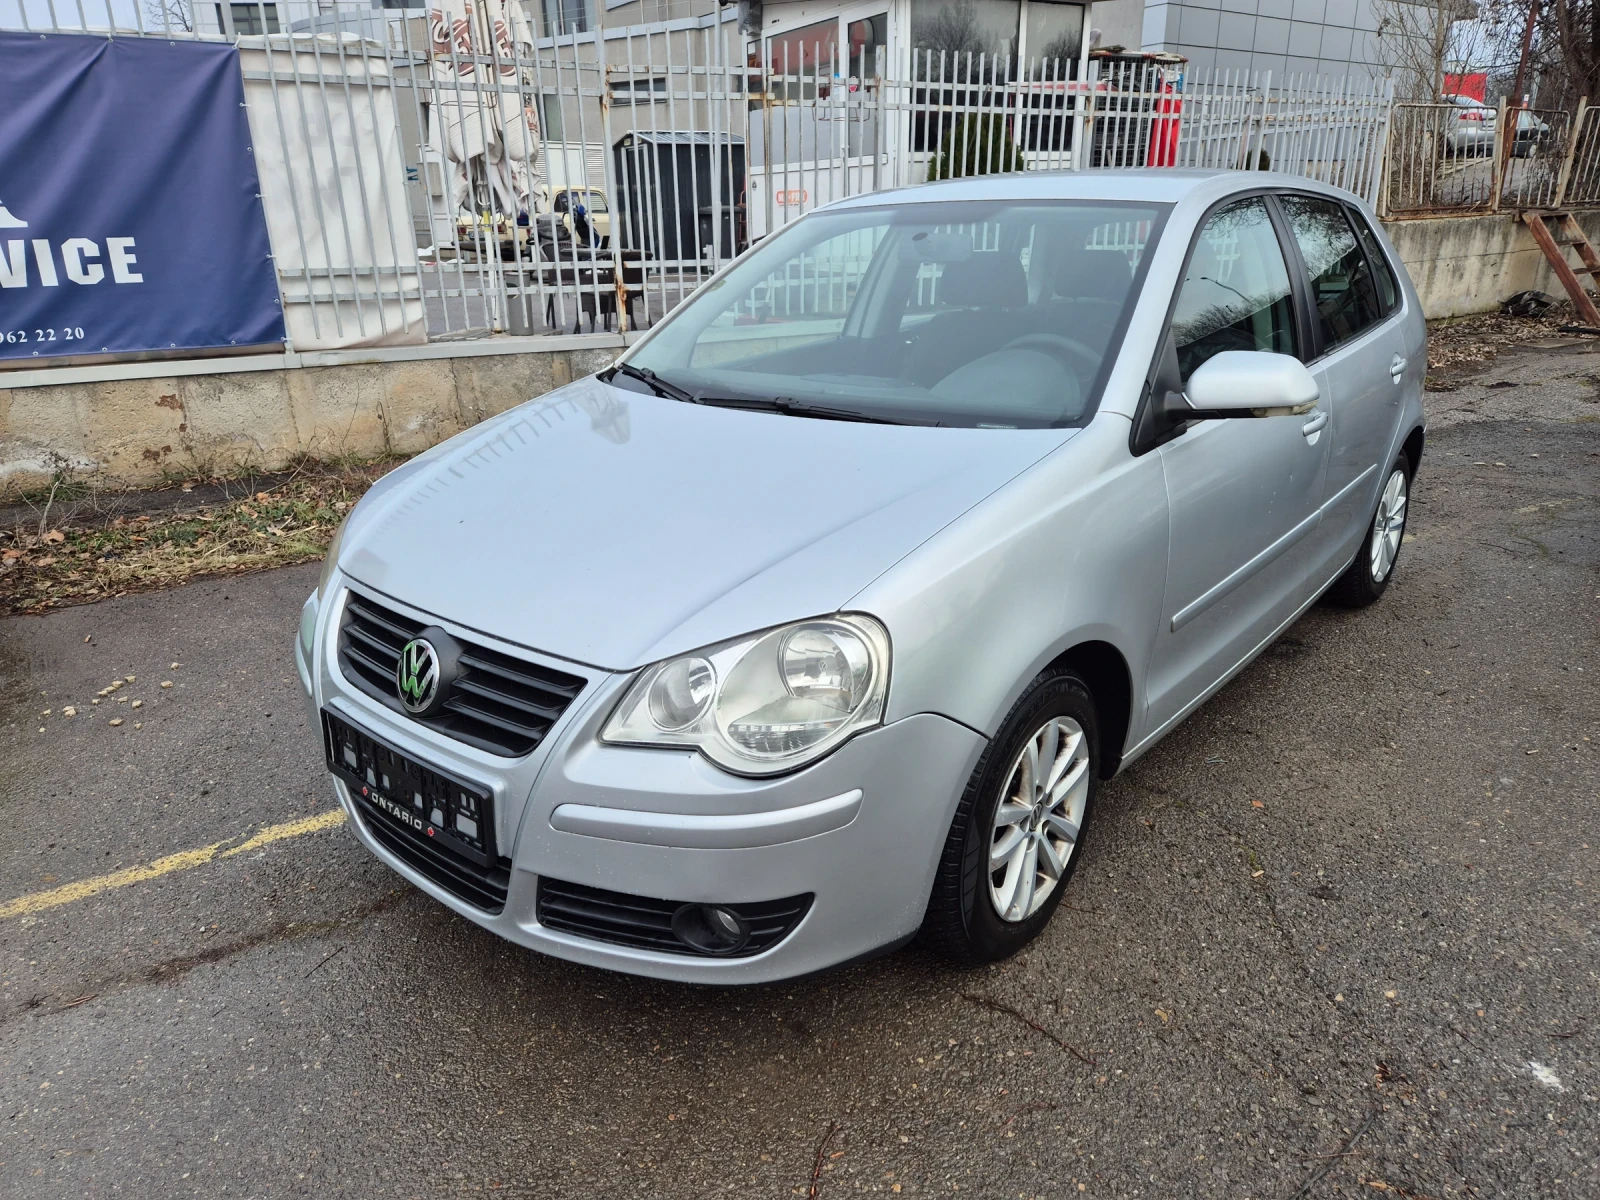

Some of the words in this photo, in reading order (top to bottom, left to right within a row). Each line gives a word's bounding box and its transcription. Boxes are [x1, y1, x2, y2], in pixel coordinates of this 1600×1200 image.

[35, 328, 57, 342] 22
[63, 326, 85, 340] 20
[371, 792, 423, 830] ONTARIO
